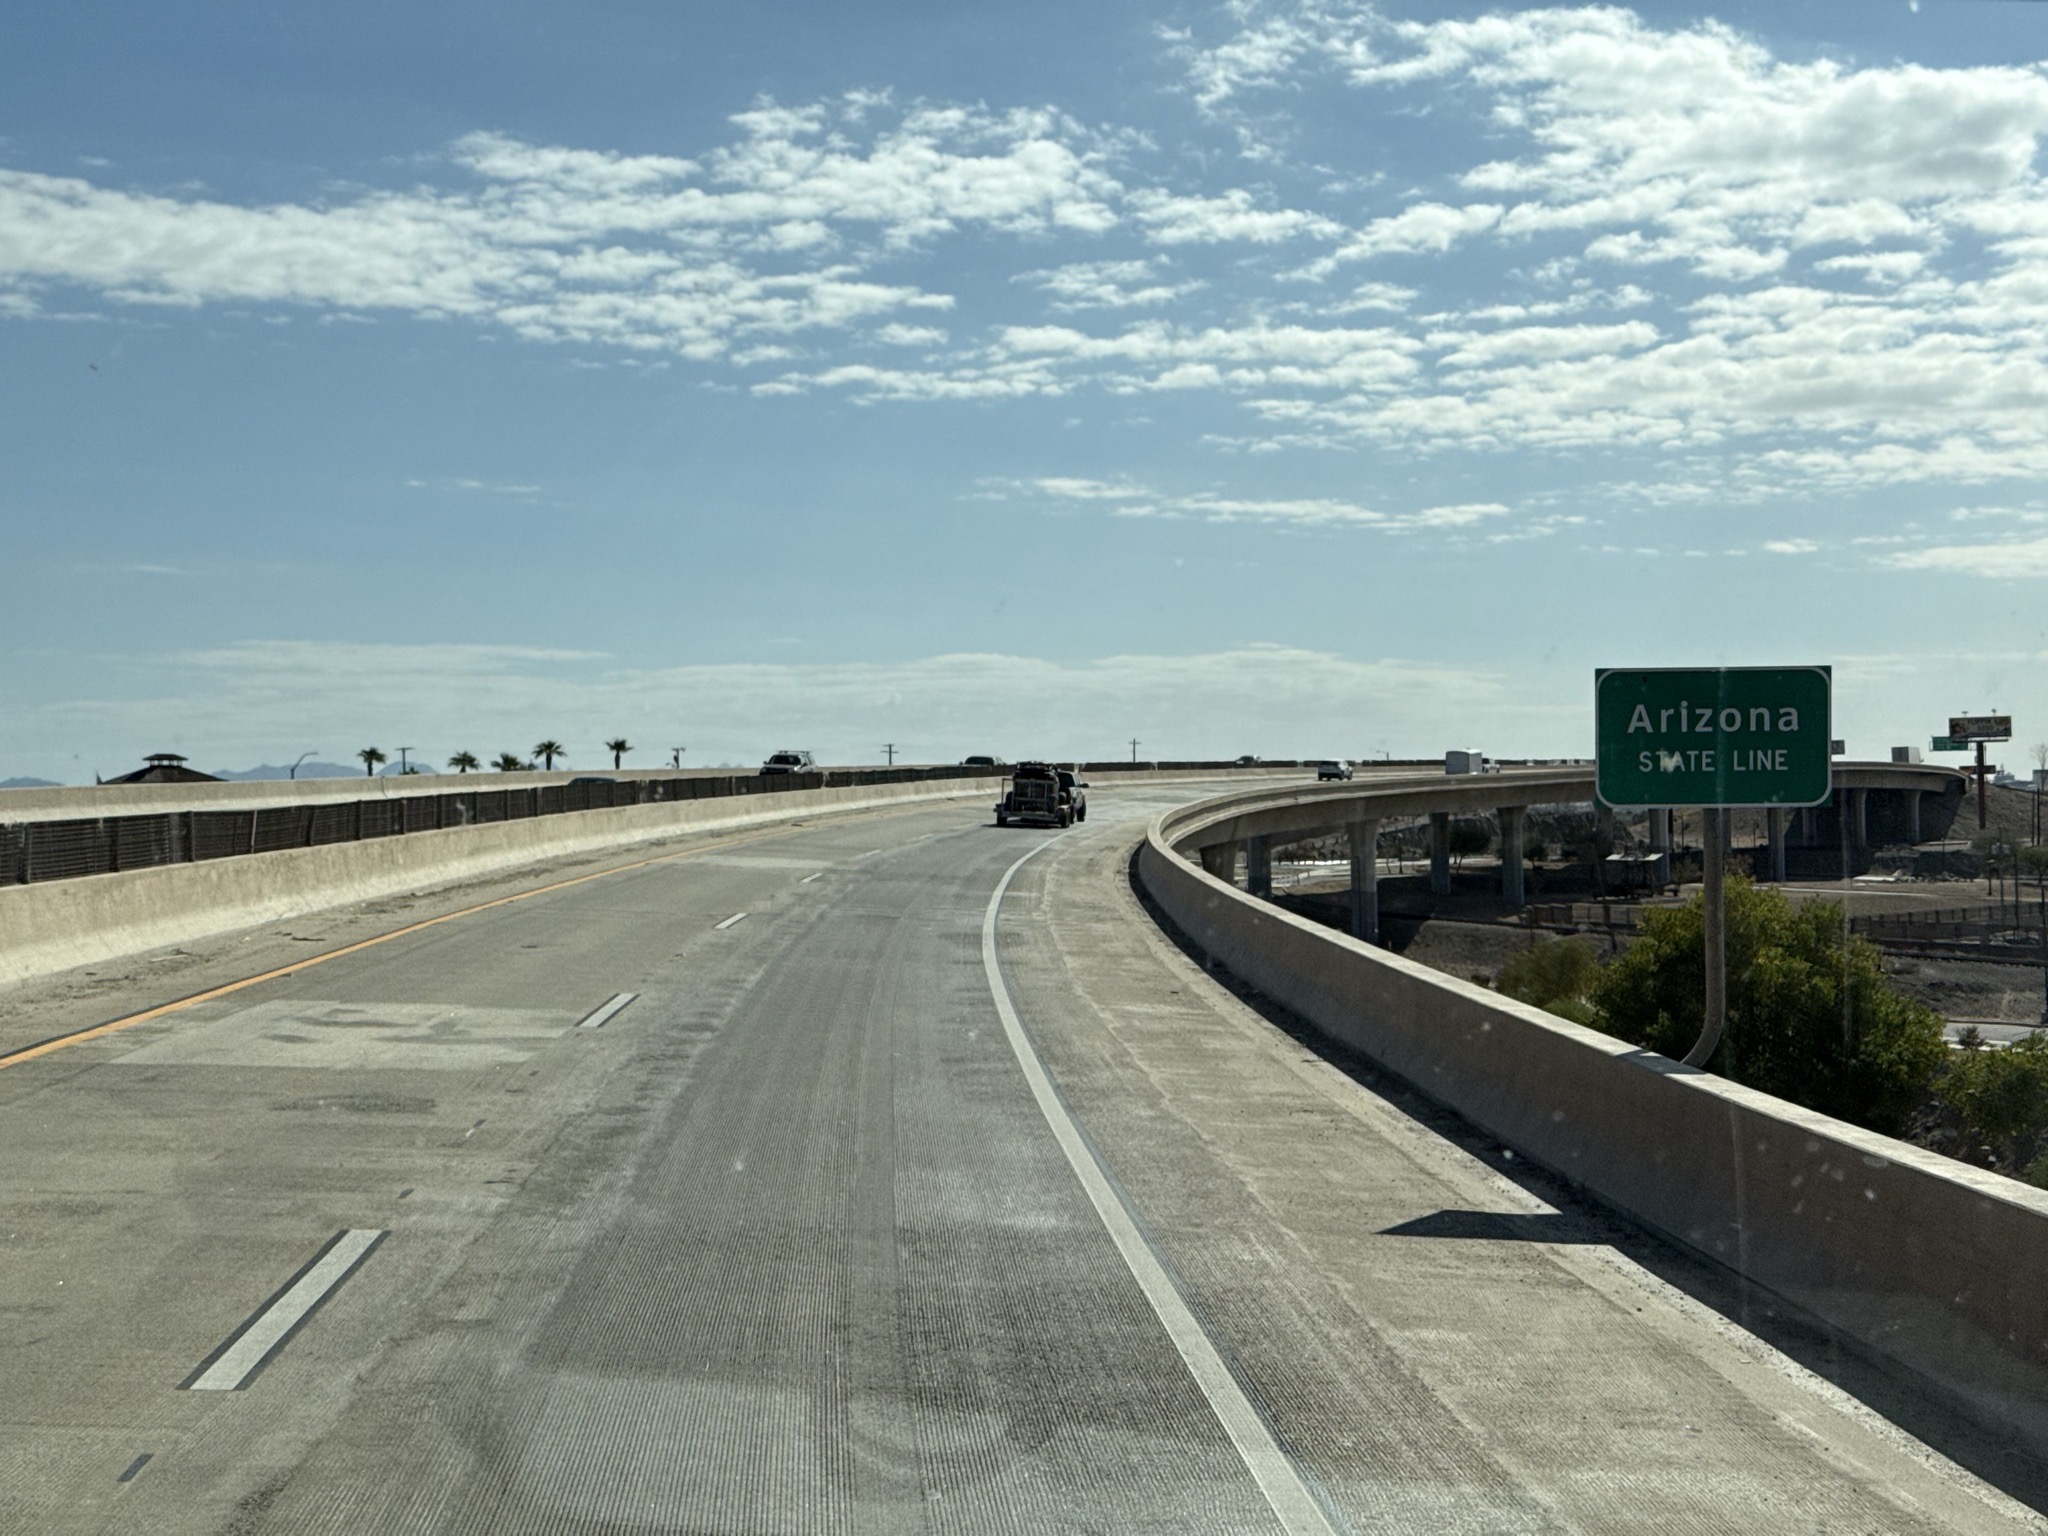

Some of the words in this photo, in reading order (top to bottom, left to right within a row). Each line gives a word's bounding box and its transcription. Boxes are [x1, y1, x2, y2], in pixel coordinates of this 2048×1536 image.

[1627, 700, 1799, 733] Arizona
[1638, 750, 1716, 772] STATE
[1733, 749, 1789, 771] LINE
